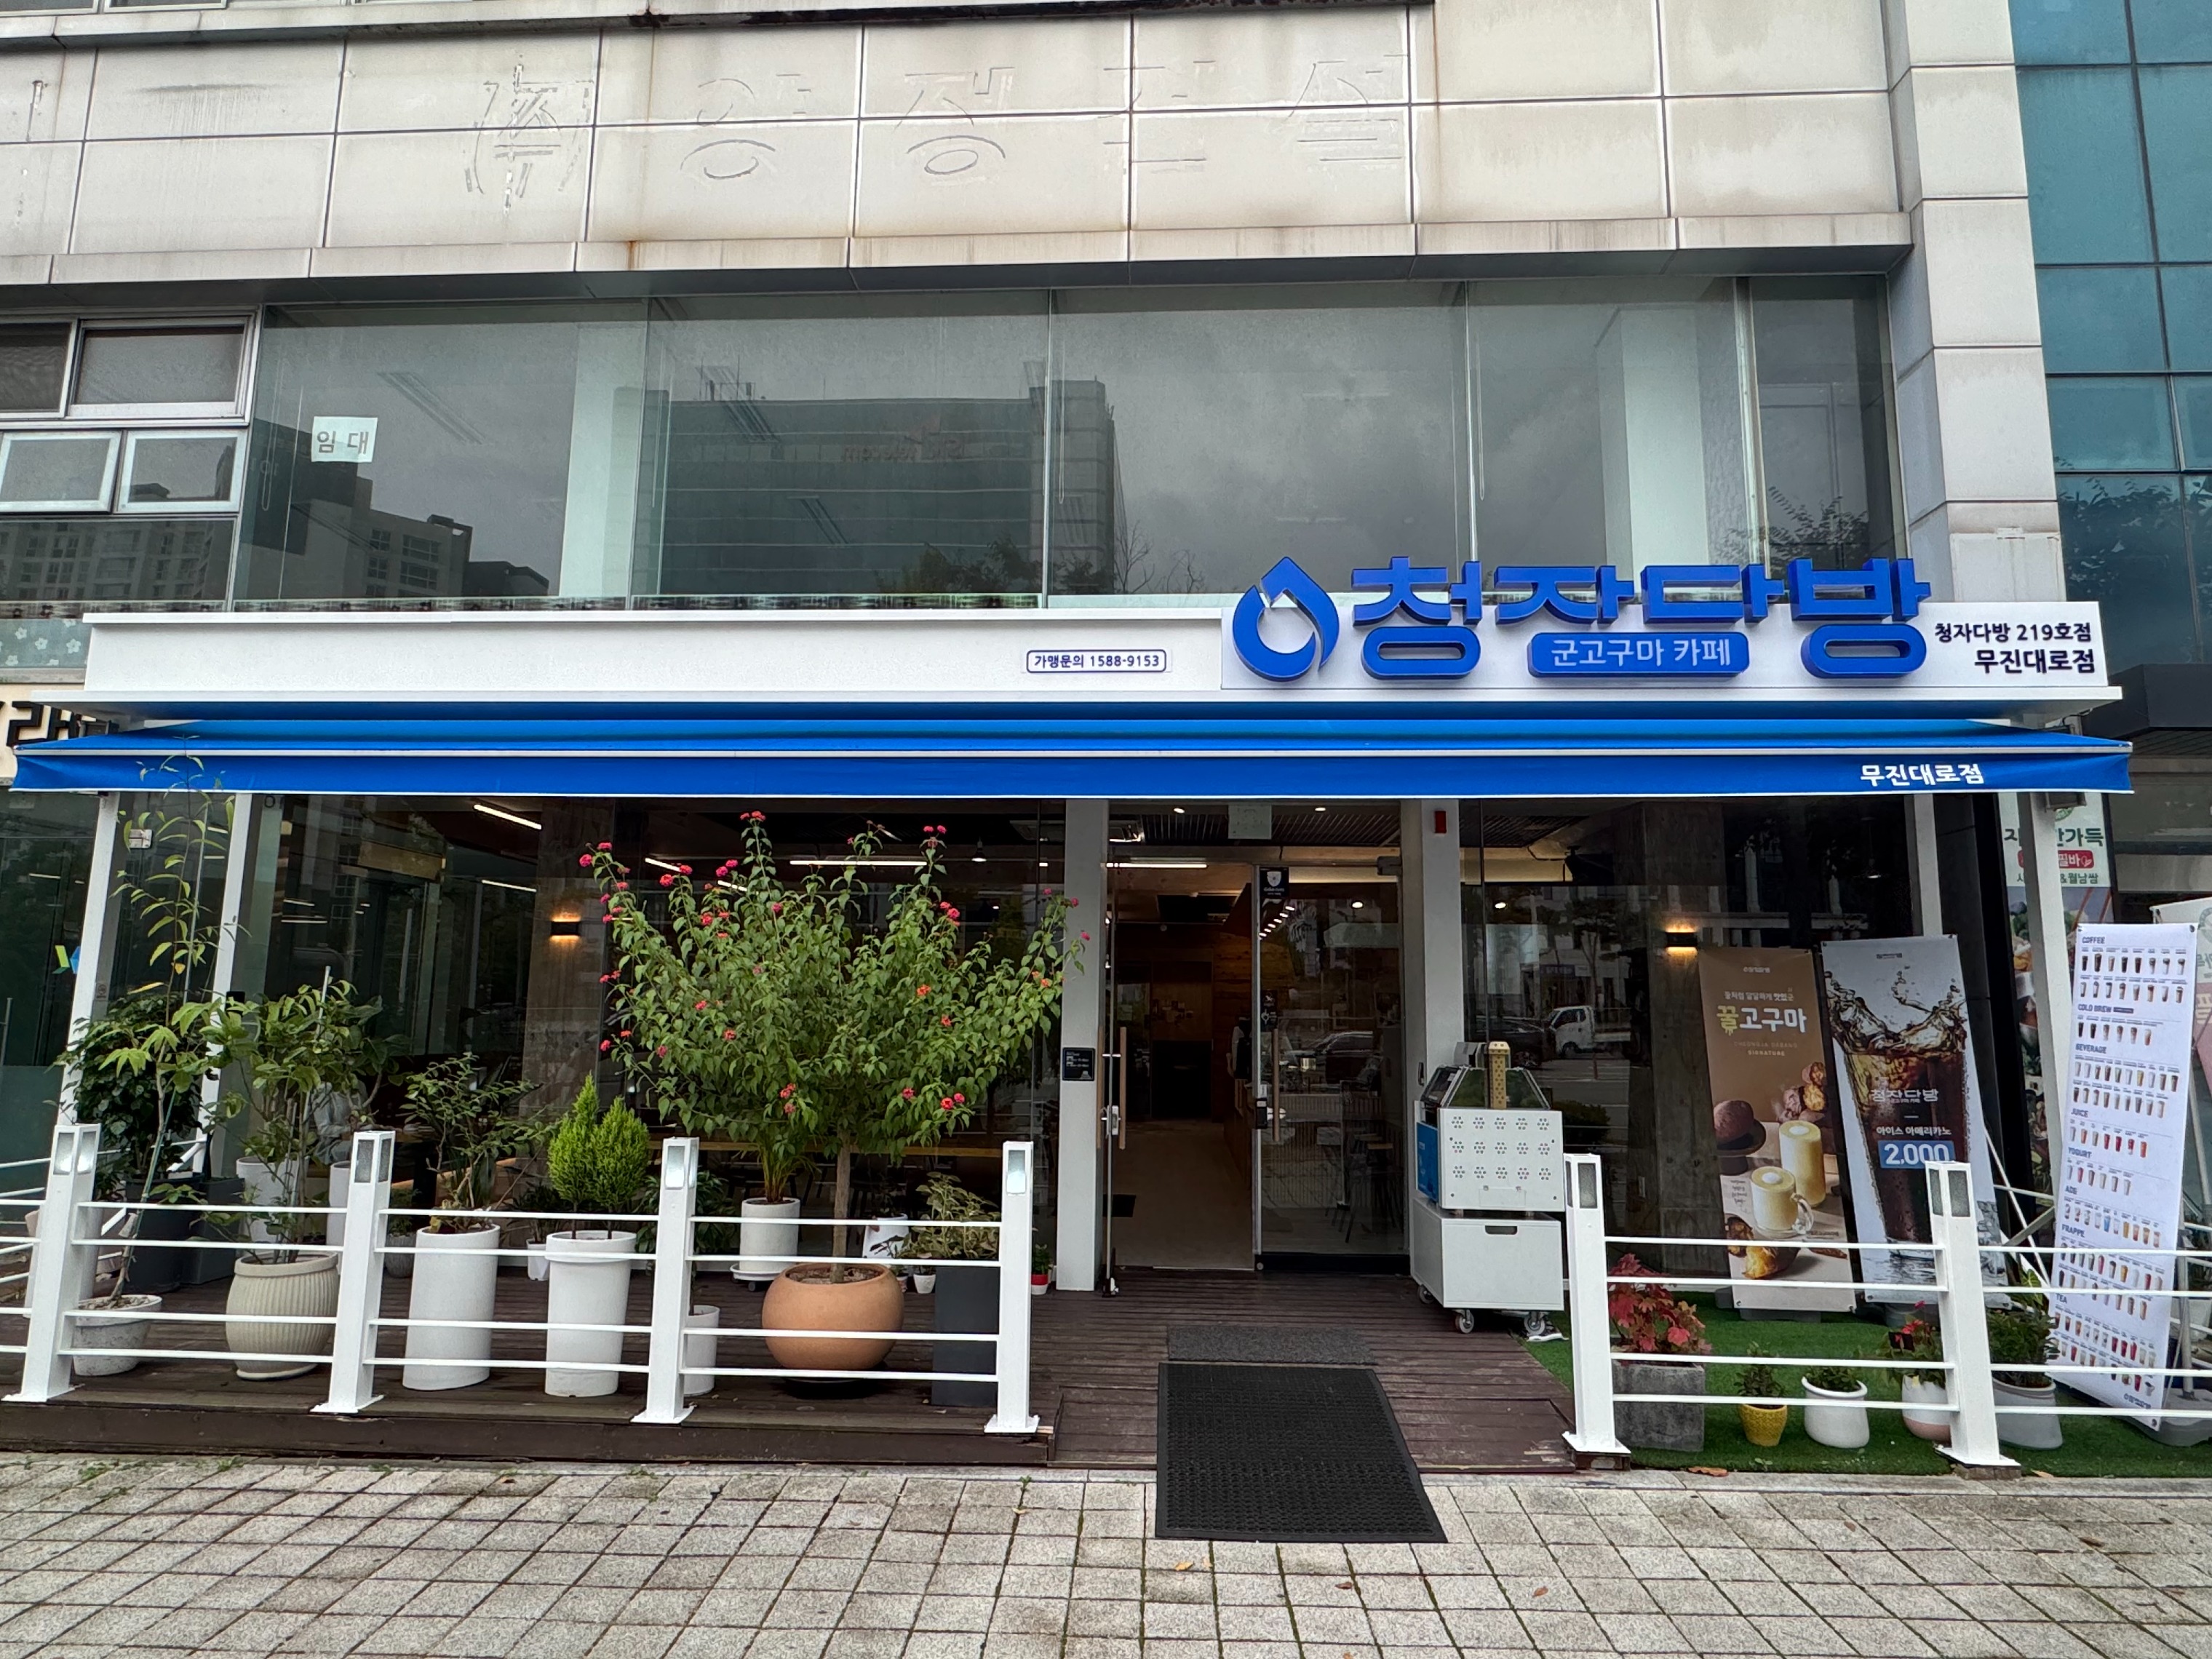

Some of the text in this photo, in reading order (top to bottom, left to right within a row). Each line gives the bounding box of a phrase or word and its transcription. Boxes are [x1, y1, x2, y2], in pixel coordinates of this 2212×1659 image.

[1351, 556, 1932, 680] 청자다방
[1934, 622, 2092, 643] 청자다방 219호점
[1034, 655, 1160, 669] 가맹문의 1588-9153
[1551, 638, 1731, 667] 군고구마 카페
[1974, 648, 2096, 675] 무진대로점
[1860, 763, 1985, 787] 무진대로점
[1716, 1005, 1807, 1036] 꿀고구마
[1875, 1126, 1953, 1137] 아이스 아메리카노
